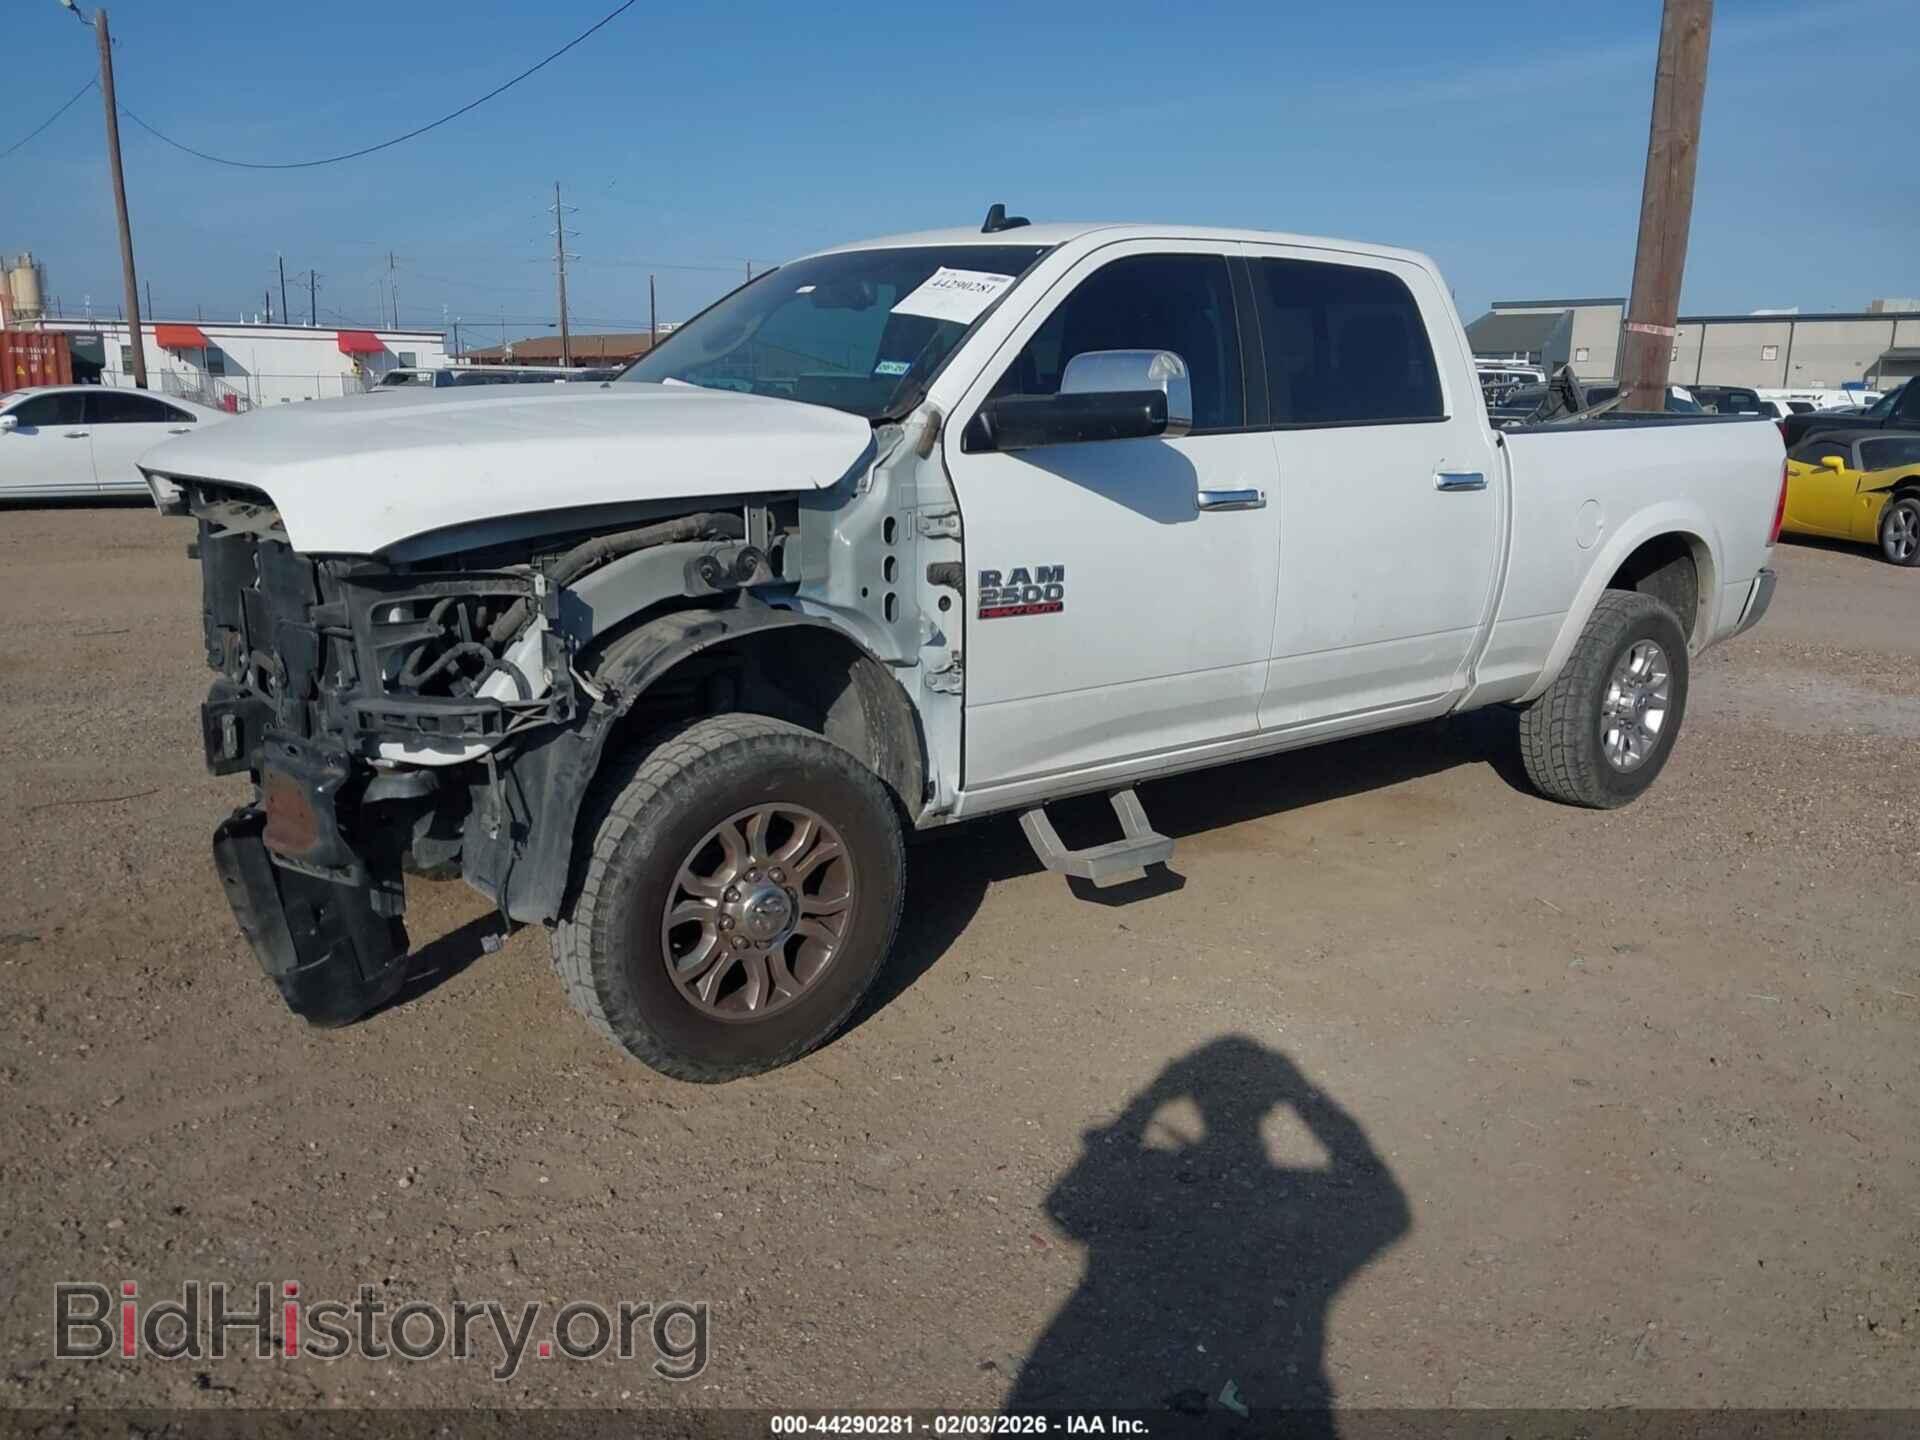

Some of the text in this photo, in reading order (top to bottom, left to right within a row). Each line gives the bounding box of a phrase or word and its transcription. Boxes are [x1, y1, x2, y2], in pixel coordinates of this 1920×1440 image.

[932, 278, 996, 294] 44290281
[979, 565, 1064, 588] RAM
[979, 584, 1064, 608] 2500
